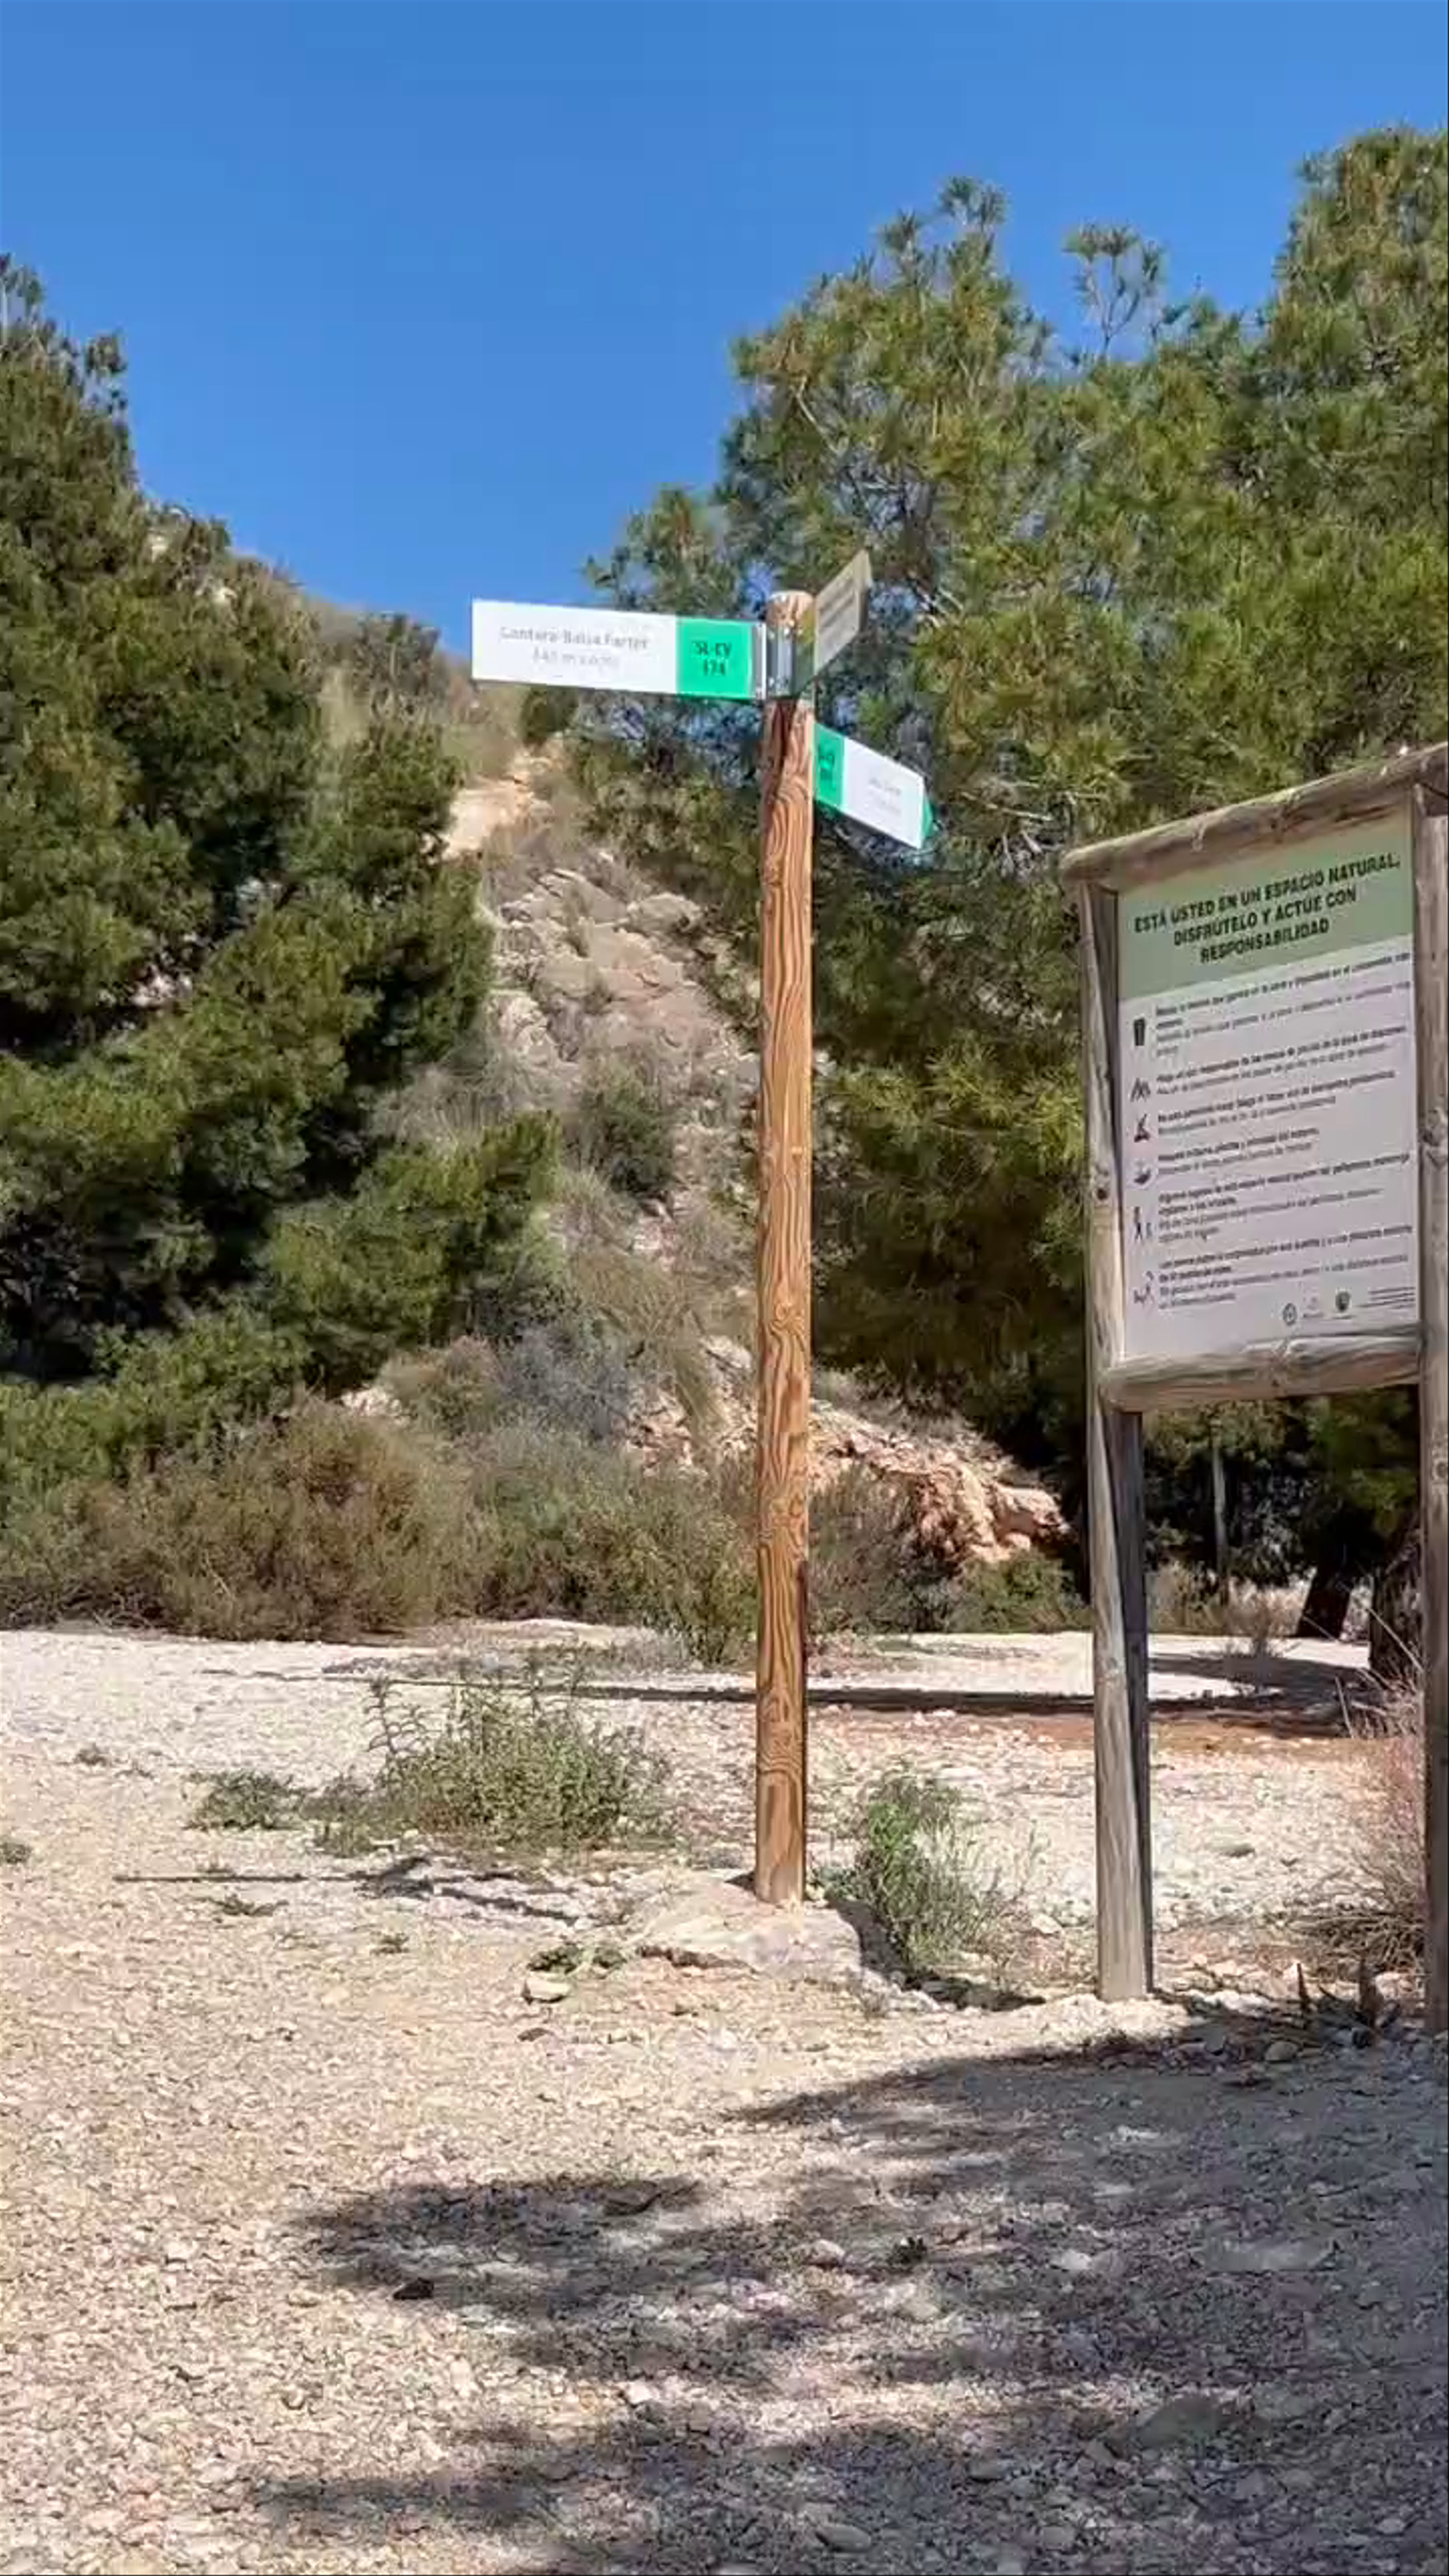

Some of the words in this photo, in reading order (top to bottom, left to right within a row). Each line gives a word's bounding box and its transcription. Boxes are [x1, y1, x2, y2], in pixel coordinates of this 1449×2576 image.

[692, 641, 732, 658] SL-CV
[1135, 906, 1168, 933] ESTÁ
[1170, 900, 1215, 923] USTED
[1218, 894, 1237, 912] EN
[1240, 886, 1261, 906] UN
[1264, 870, 1324, 901] ESPACIO
[1174, 912, 1258, 946] DISFRÚTELO
[1262, 907, 1271, 924] Y
[1325, 885, 1356, 907] CON
[1200, 917, 1330, 963] RESPONSABILIDAD
